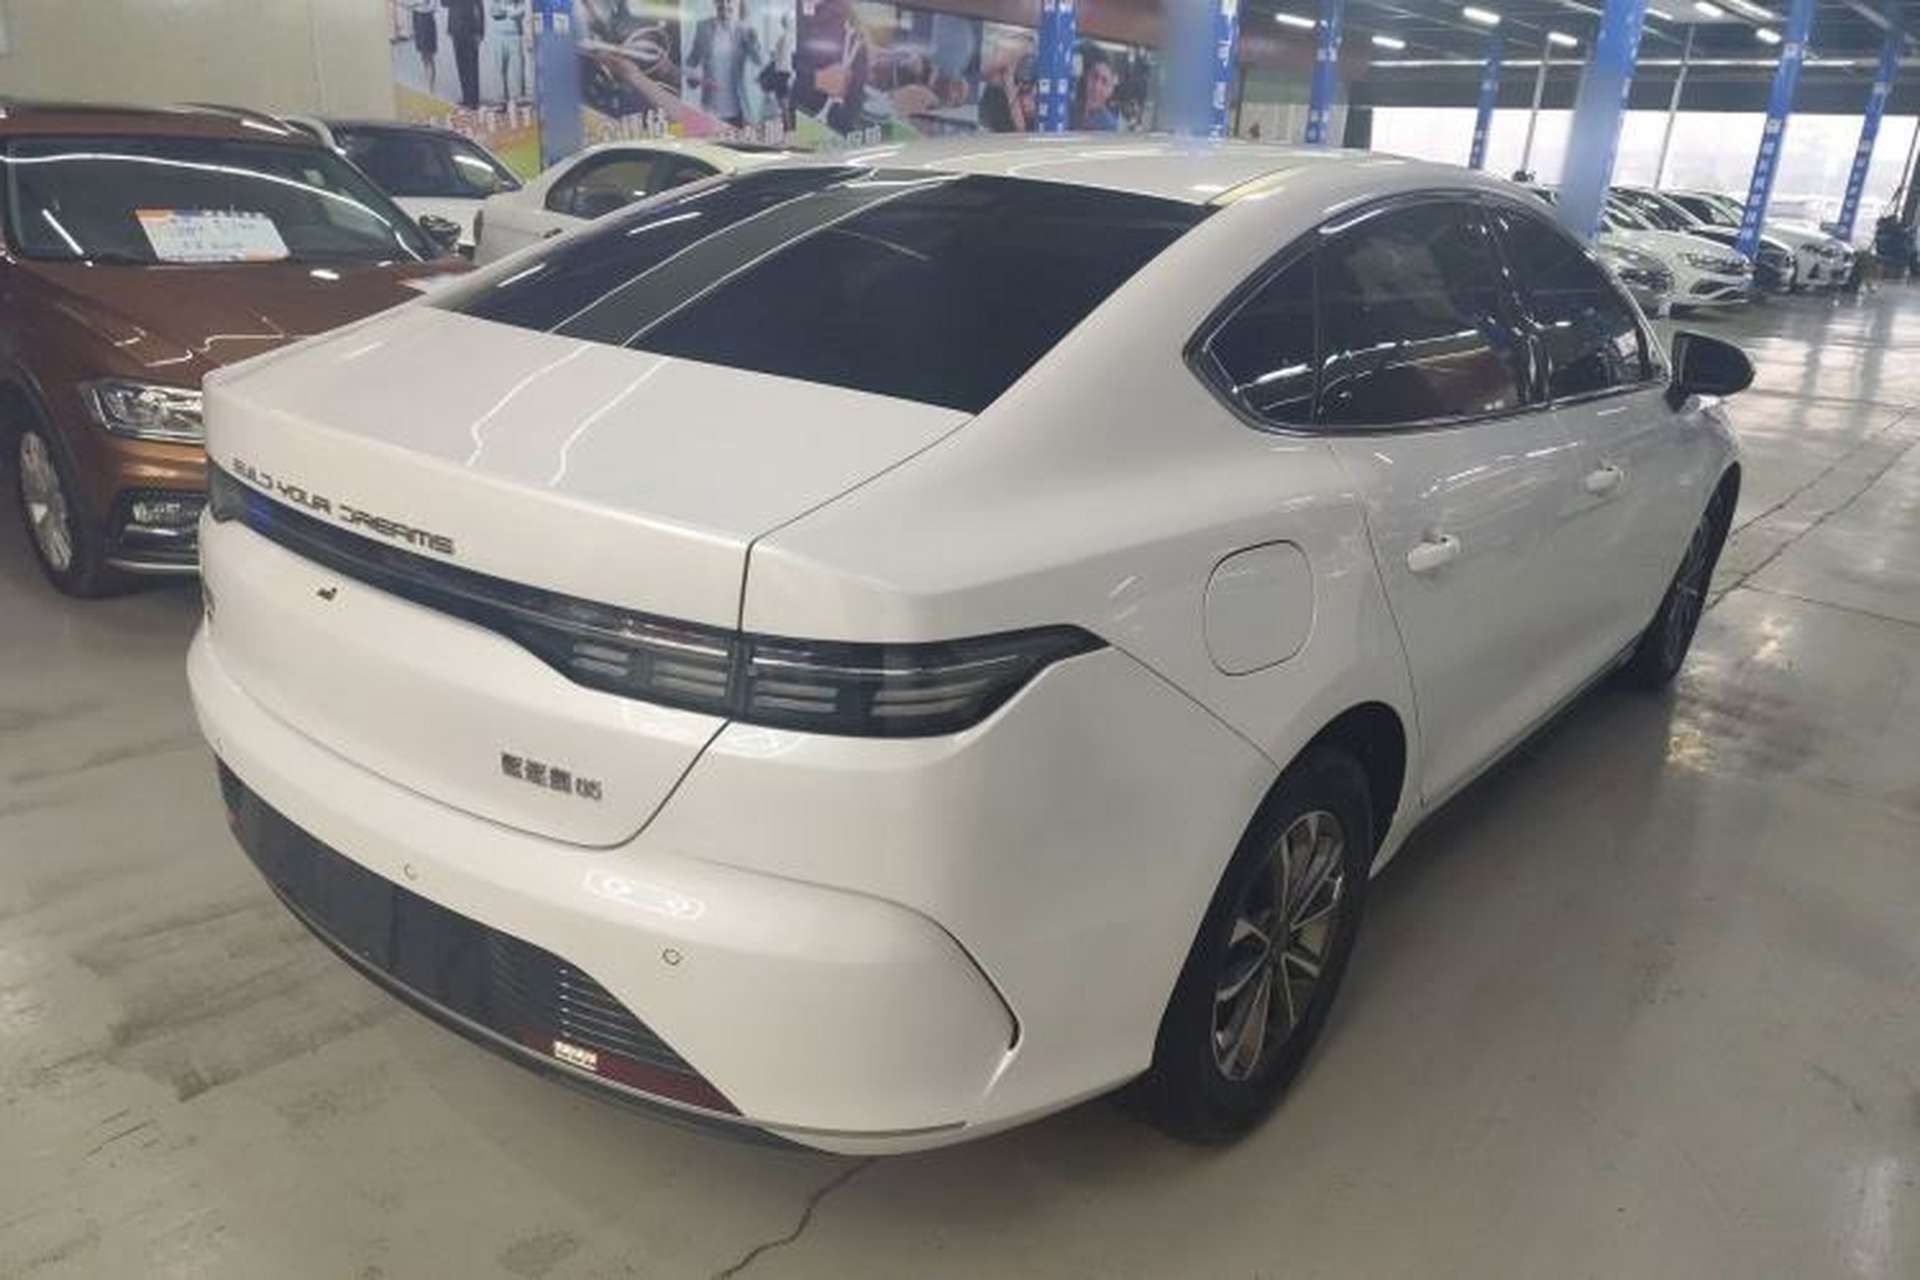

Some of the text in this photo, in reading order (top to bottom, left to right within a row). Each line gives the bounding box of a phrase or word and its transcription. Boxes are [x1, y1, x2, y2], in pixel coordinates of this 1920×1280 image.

[232, 457, 455, 553] BUILD YOUR DREAMS
